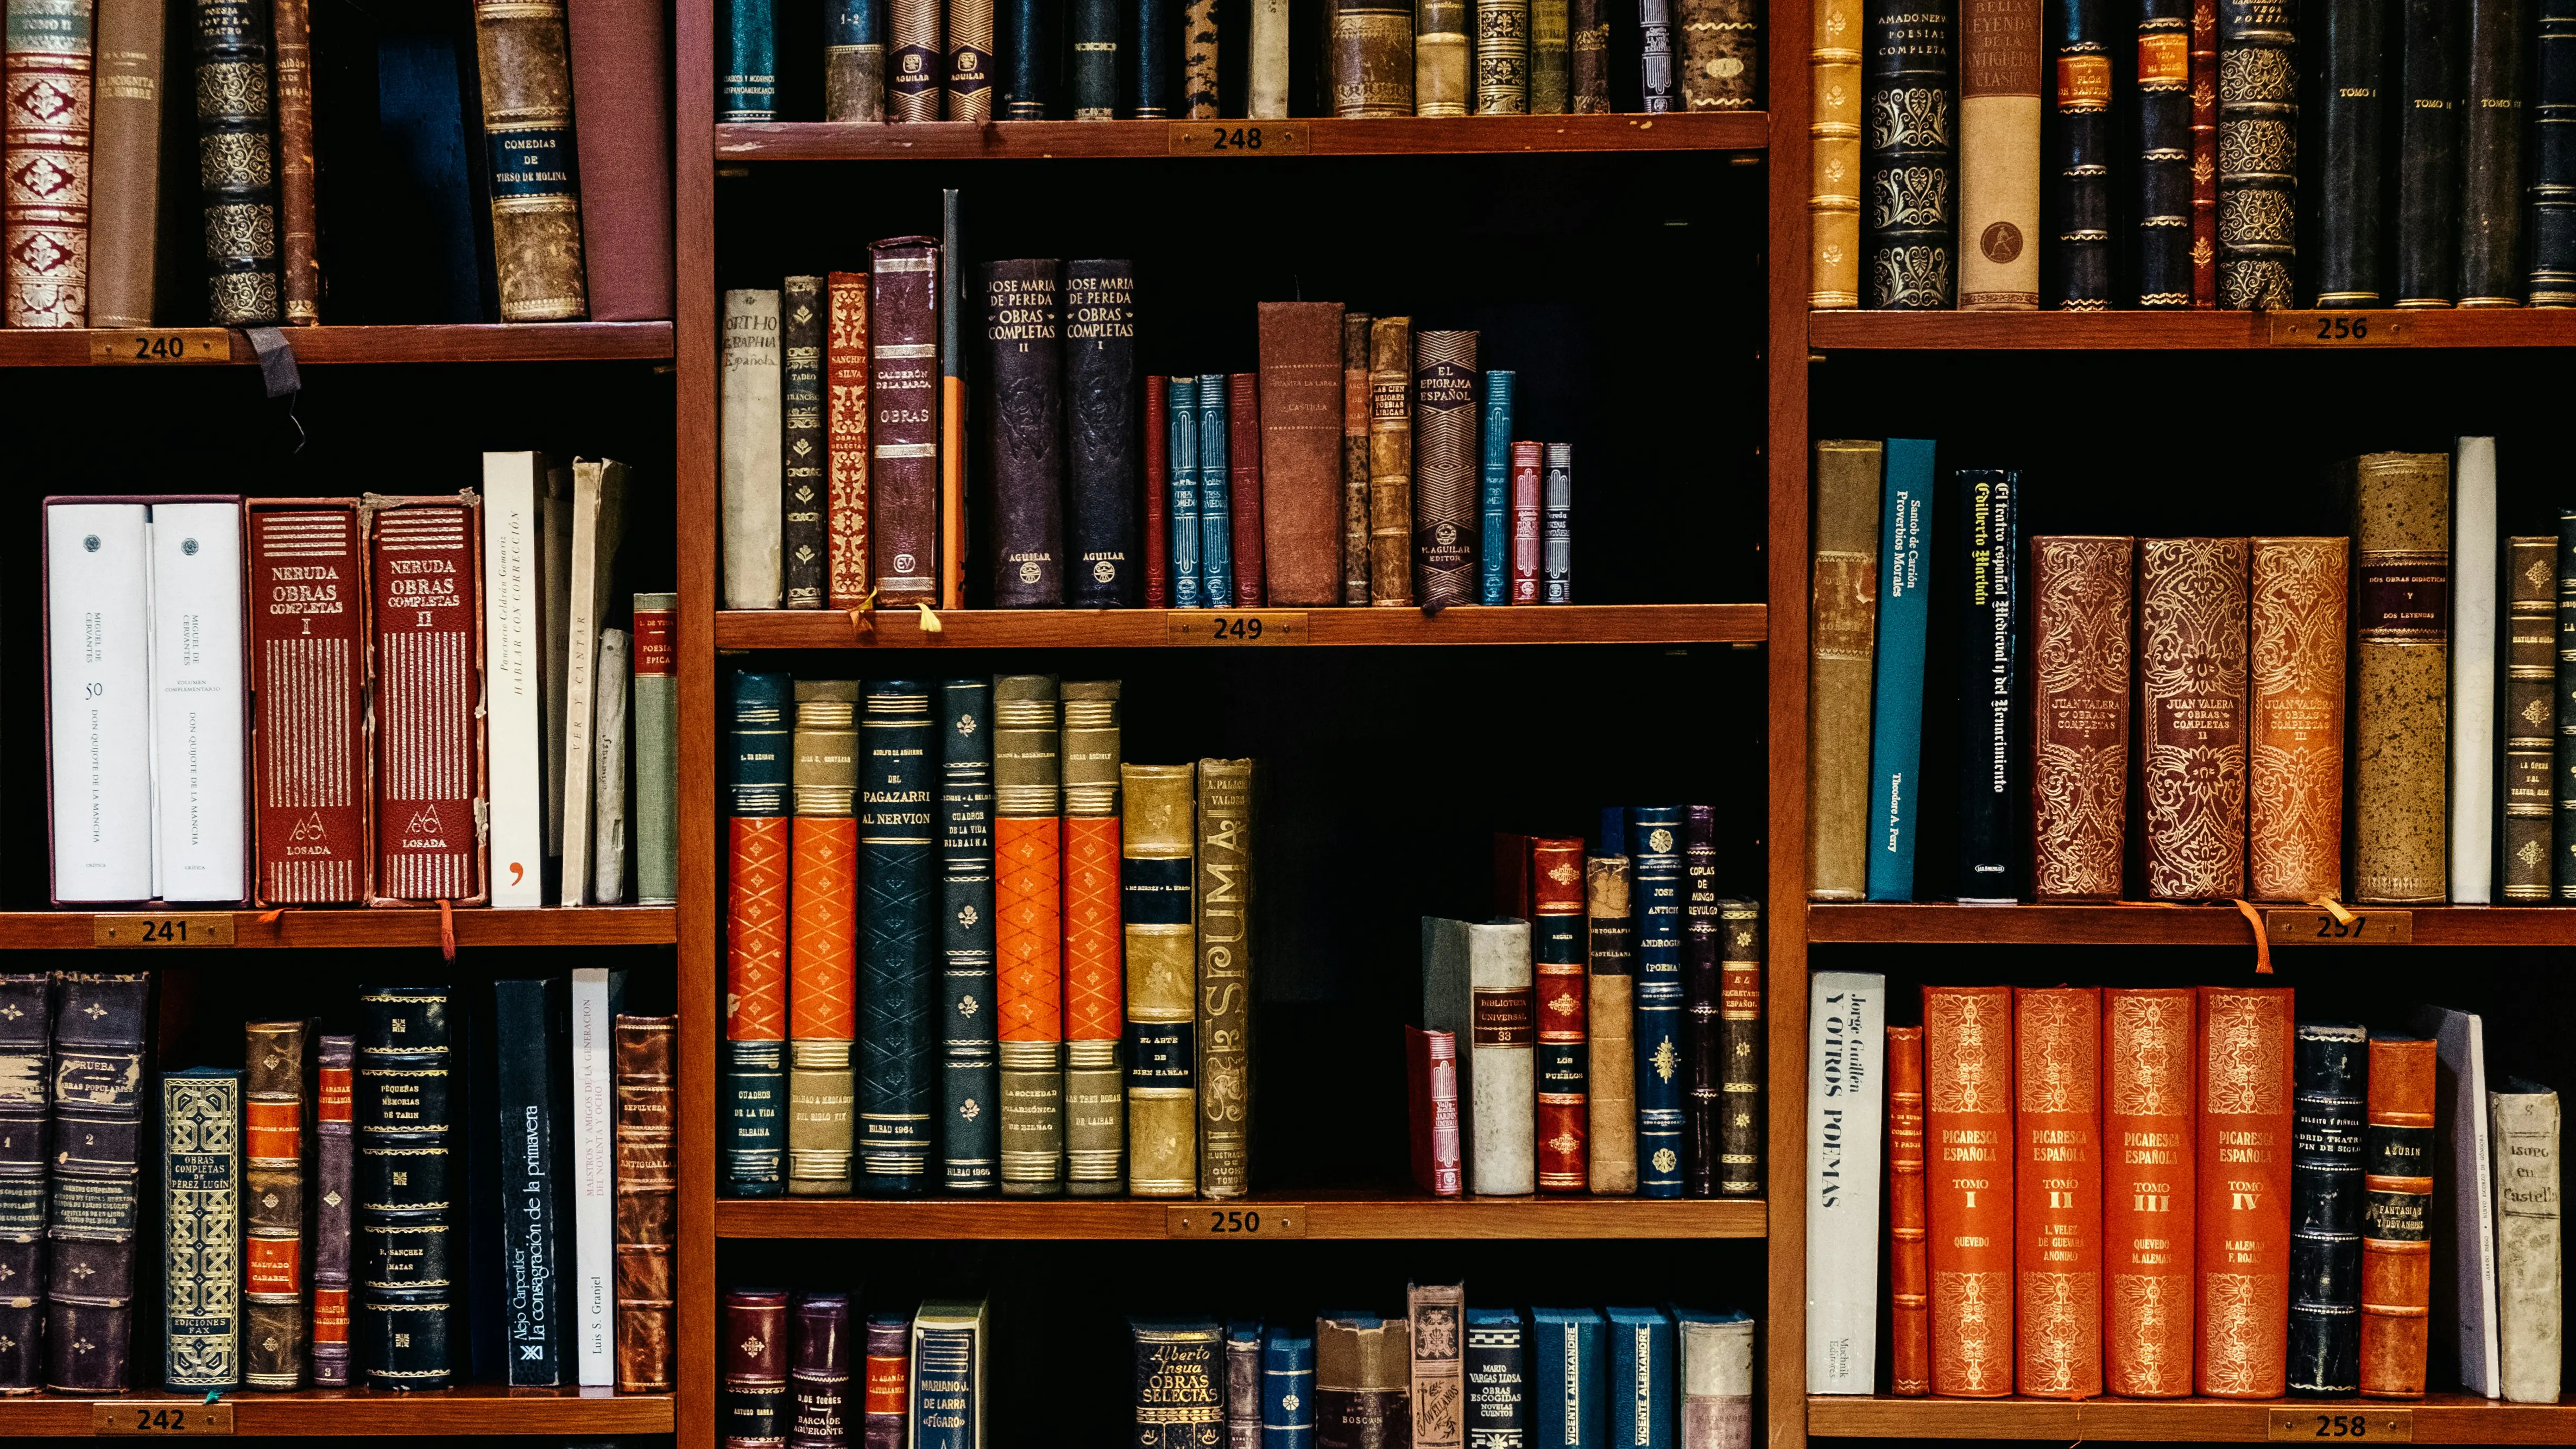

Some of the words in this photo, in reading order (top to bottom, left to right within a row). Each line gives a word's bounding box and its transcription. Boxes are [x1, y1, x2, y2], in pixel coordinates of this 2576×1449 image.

[1879, 14, 1919, 24] AMADO
[2340, 88, 2369, 97] TOMO
[2415, 99, 2444, 108] TOMO
[504, 140, 555, 149] COMEDIAS
[1213, 128, 1262, 149] 248
[524, 155, 538, 164] DE
[496, 173, 520, 182] TIRSO
[522, 173, 534, 181] DE
[535, 171, 567, 181] MOLINA
[987, 280, 1017, 292] JOSE
[1021, 280, 1055, 291] MARIA
[1066, 278, 1096, 291] JOSE
[1100, 278, 1134, 290] MARIA
[990, 295, 1003, 306] DE
[1009, 294, 1052, 306] PEREDA
[1070, 293, 1082, 304] DE
[1088, 292, 1131, 304] PEREDA
[1000, 310, 1043, 324] OBRAS
[1078, 308, 1121, 322] OBRAS
[989, 325, 1055, 339] COMPLETAS
[1068, 324, 1133, 338] COMPLETAS
[2317, 317, 2367, 339] 256
[136, 337, 183, 358] 240
[1019, 343, 1028, 352] II
[1098, 341, 1103, 349] I
[1438, 367, 1453, 376] EL
[1420, 379, 1471, 388] EPIGRAMA
[1420, 389, 1470, 401] ESPAÑOL
[880, 410, 929, 423] OBRAS
[1894, 491, 1909, 551] Proverbios
[1910, 500, 1921, 536] Santob
[1910, 537, 1919, 549] de
[498, 536, 507, 577] Gomariz
[508, 511, 520, 601] CORRECCIÓN
[1009, 553, 1050, 562] AGUILAR
[1083, 552, 1125, 561] AGUILAR
[272, 566, 339, 581] NERUDA
[390, 560, 456, 574] NERUDA
[1907, 550, 1918, 588] Carrión
[1892, 552, 1905, 597] Morales
[273, 585, 337, 602] OBRAS
[391, 578, 454, 595] OBRAS
[388, 595, 460, 607] COMPLETAS
[499, 581, 508, 620] Celdrán
[270, 602, 343, 614] COMPLETAS
[302, 618, 311, 634] I
[416, 611, 433, 627] II
[513, 607, 522, 633] CON
[1214, 618, 1262, 639] 249
[500, 624, 509, 671] Pancracio
[576, 617, 586, 684] CANTAR
[95, 650, 102, 662] DE
[513, 641, 523, 695] HABLAR
[85, 683, 102, 700] 50
[2167, 700, 2195, 709] JUAN
[2198, 700, 2234, 708] VALERA
[573, 721, 582, 749] VER
[92, 774, 99, 786] DE
[888, 775, 901, 783] DEL
[93, 790, 99, 800] LA
[864, 792, 930, 802] PAGAZARRI
[1891, 773, 1901, 814] Theodore
[863, 814, 875, 824] AL
[877, 814, 930, 824] NERVION
[1890, 816, 1899, 826] A.
[402, 839, 446, 848] LOSADA
[1887, 828, 1899, 852] Perry
[287, 845, 331, 855] LOSADA
[1690, 867, 1715, 875] COPLAS
[1697, 880, 1707, 889] DE
[1692, 892, 1714, 902] MINGO
[1689, 906, 1718, 915] REVULGO
[142, 921, 186, 941] 241
[2317, 916, 2366, 937] 257
[1826, 993, 1845, 1010] Y
[1482, 1013, 1526, 1021] UNIVERSAL
[1847, 994, 1866, 1034] Jorge
[1498, 1031, 1511, 1041] 33
[1824, 1017, 1843, 1097] OTROS
[1849, 1040, 1865, 1093] Guillén
[523, 1105, 545, 1176] primavera
[1943, 1130, 1998, 1144] PICARESCA
[2219, 1131, 2274, 1145] PICARESCA
[1822, 1108, 1842, 1208] POEMAS
[1943, 1147, 1996, 1161] ESPAÑOLA
[2220, 1148, 2271, 1162] ESPAÑOLA
[175, 1165, 224, 1173] COMPLETAS
[172, 1179, 199, 1188] PÉREZ
[523, 1180, 540, 1193] la
[1953, 1179, 1988, 1189] TOMO
[2228, 1181, 2264, 1191] TOMO
[1966, 1192, 1976, 1208] I
[2232, 1193, 2261, 1210] IV
[523, 1197, 540, 1220] de
[1211, 1212, 1259, 1232] 250
[1955, 1237, 1989, 1248] QUEVEDO
[512, 1249, 530, 1308] Carpentier
[526, 1224, 549, 1321] consagración
[591, 1276, 602, 1314] Granjel
[513, 1312, 529, 1340] Alejo
[592, 1320, 602, 1330] S.
[528, 1324, 545, 1341] La
[592, 1333, 602, 1354] Luis
[1150, 1346, 1210, 1361] Alberto
[1829, 1340, 1839, 1378] Editores
[1840, 1338, 1849, 1378] Muchnik
[1157, 1360, 1202, 1374] Insua
[1567, 1327, 1576, 1395] ALEIXANDRE
[1638, 1328, 1647, 1395] ALEIXANDRE
[1150, 1376, 1209, 1389] OBRAS
[1469, 1373, 1496, 1383] VARGAS
[1498, 1374, 1521, 1383] LLOSA
[922, 1381, 960, 1391] MARIANO
[1143, 1388, 1217, 1402] SELECTAS
[924, 1400, 935, 1408] DE
[938, 1400, 965, 1409] LARRA
[137, 1409, 185, 1431] 242
[1567, 1398, 1576, 1444] VICENTE
[1638, 1398, 1647, 1444] VICENTE
[2316, 1415, 2366, 1437] 258
